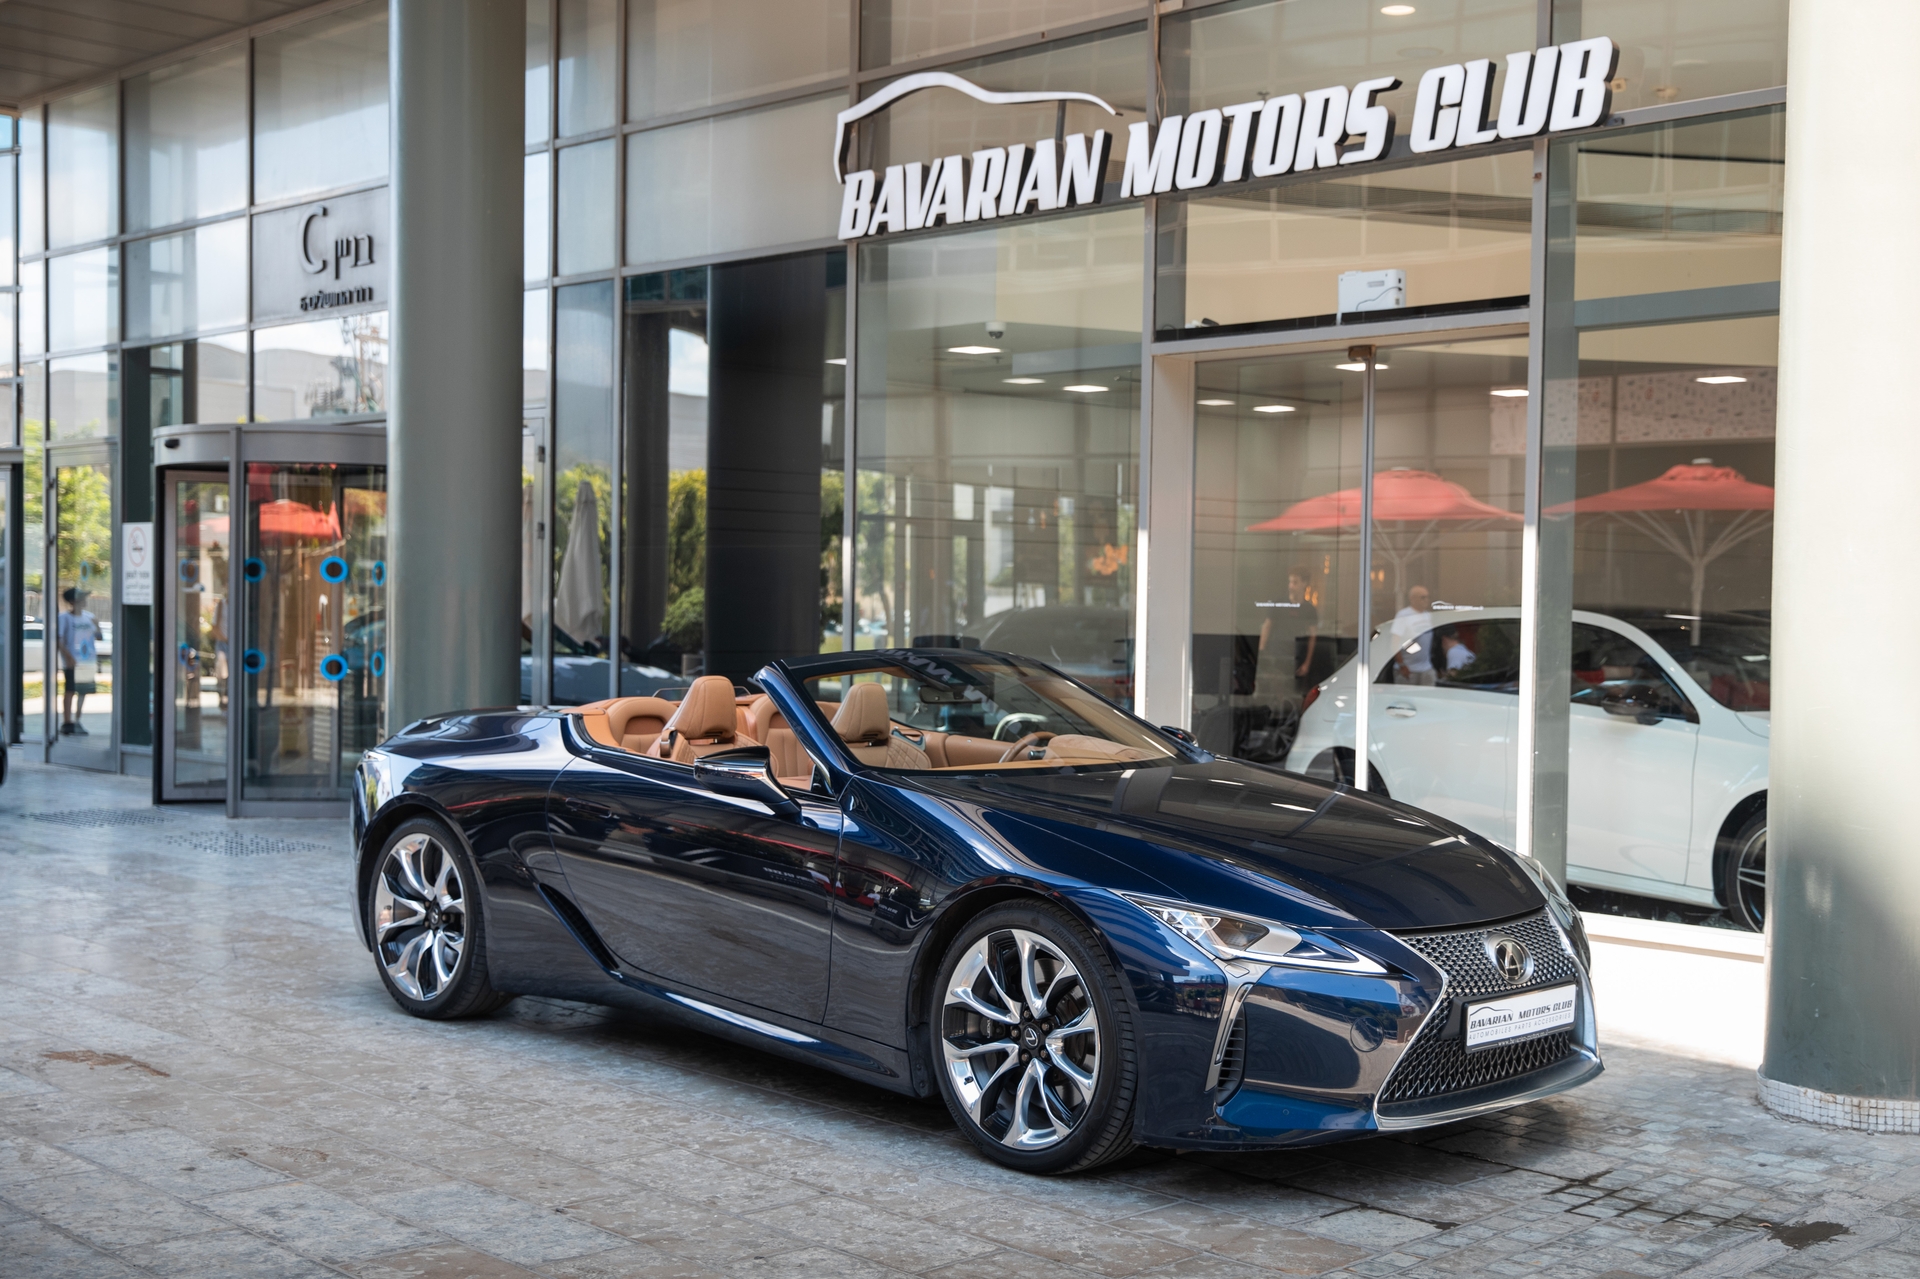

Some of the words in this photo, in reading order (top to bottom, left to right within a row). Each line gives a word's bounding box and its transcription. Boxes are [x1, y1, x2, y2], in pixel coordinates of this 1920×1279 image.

[838, 129, 1112, 241] BAVARIAN
[1120, 77, 1401, 199] MOTORS
[1409, 36, 1620, 154] CLUB
[299, 204, 328, 275] C
[1050, 924, 1095, 977] BRIDGESTONE
[1469, 1026, 1512, 1040] AUTOMOBILES
[1514, 1021, 1532, 1031] PARTS
[1534, 1013, 1571, 1026] ACCESSORIES
[1470, 1013, 1513, 1029] BAVARIAN
[1518, 1005, 1551, 1019] MOTORS
[1553, 1000, 1573, 1011] CLUB
